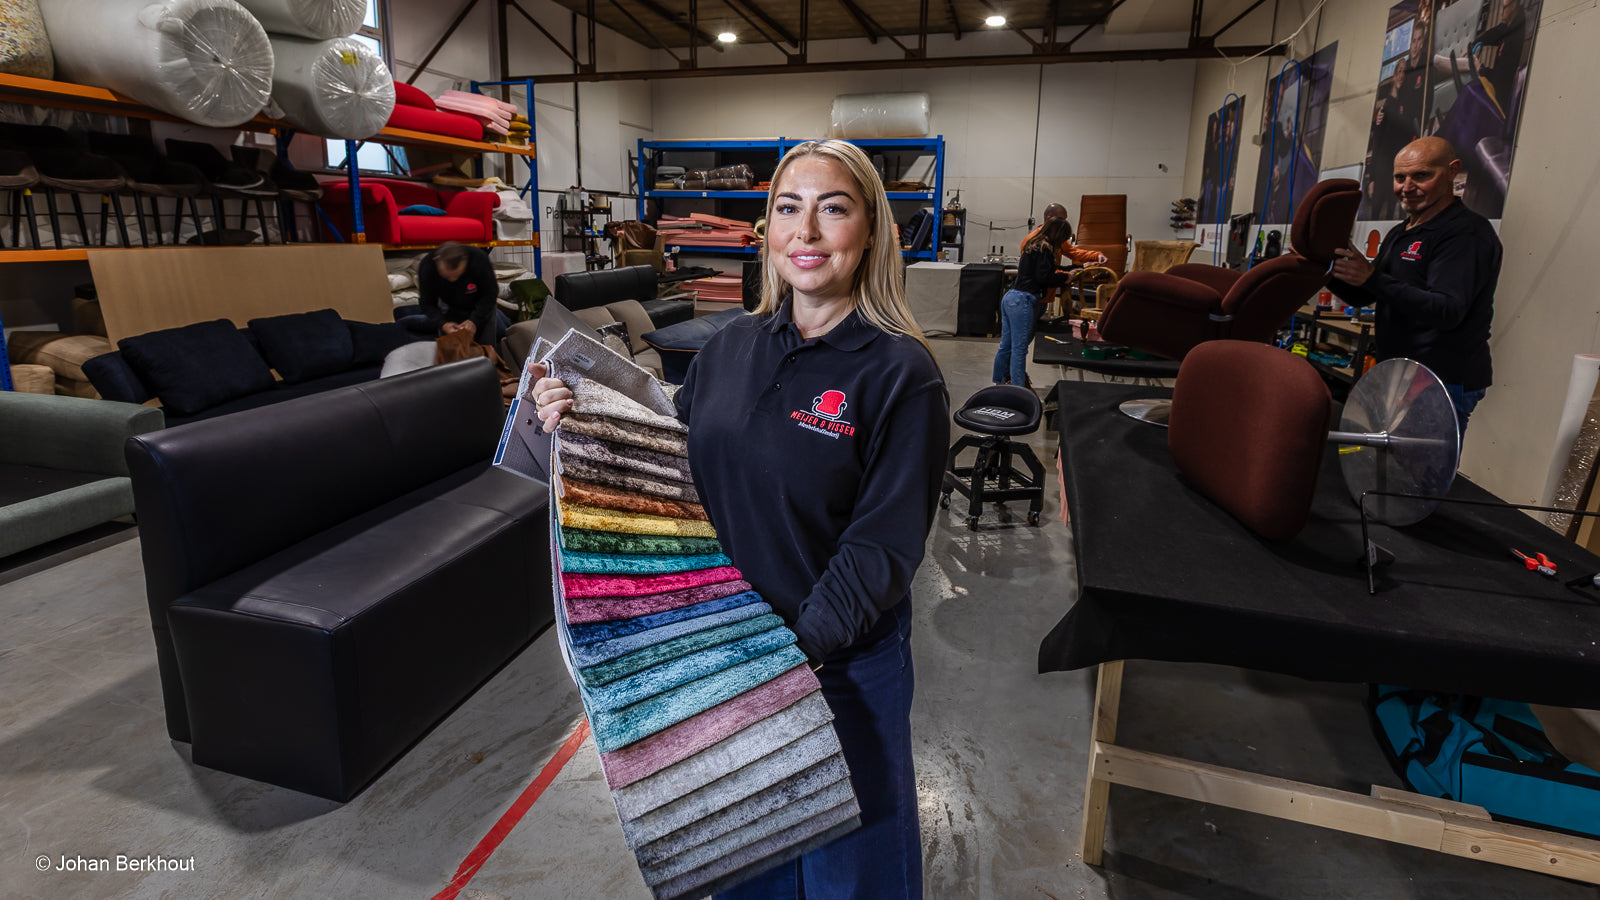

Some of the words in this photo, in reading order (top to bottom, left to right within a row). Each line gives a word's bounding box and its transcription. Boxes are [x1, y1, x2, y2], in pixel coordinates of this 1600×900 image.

[790, 410, 819, 426] MEIJER
[819, 420, 826, 428] &
[827, 421, 855, 437] VISSER
